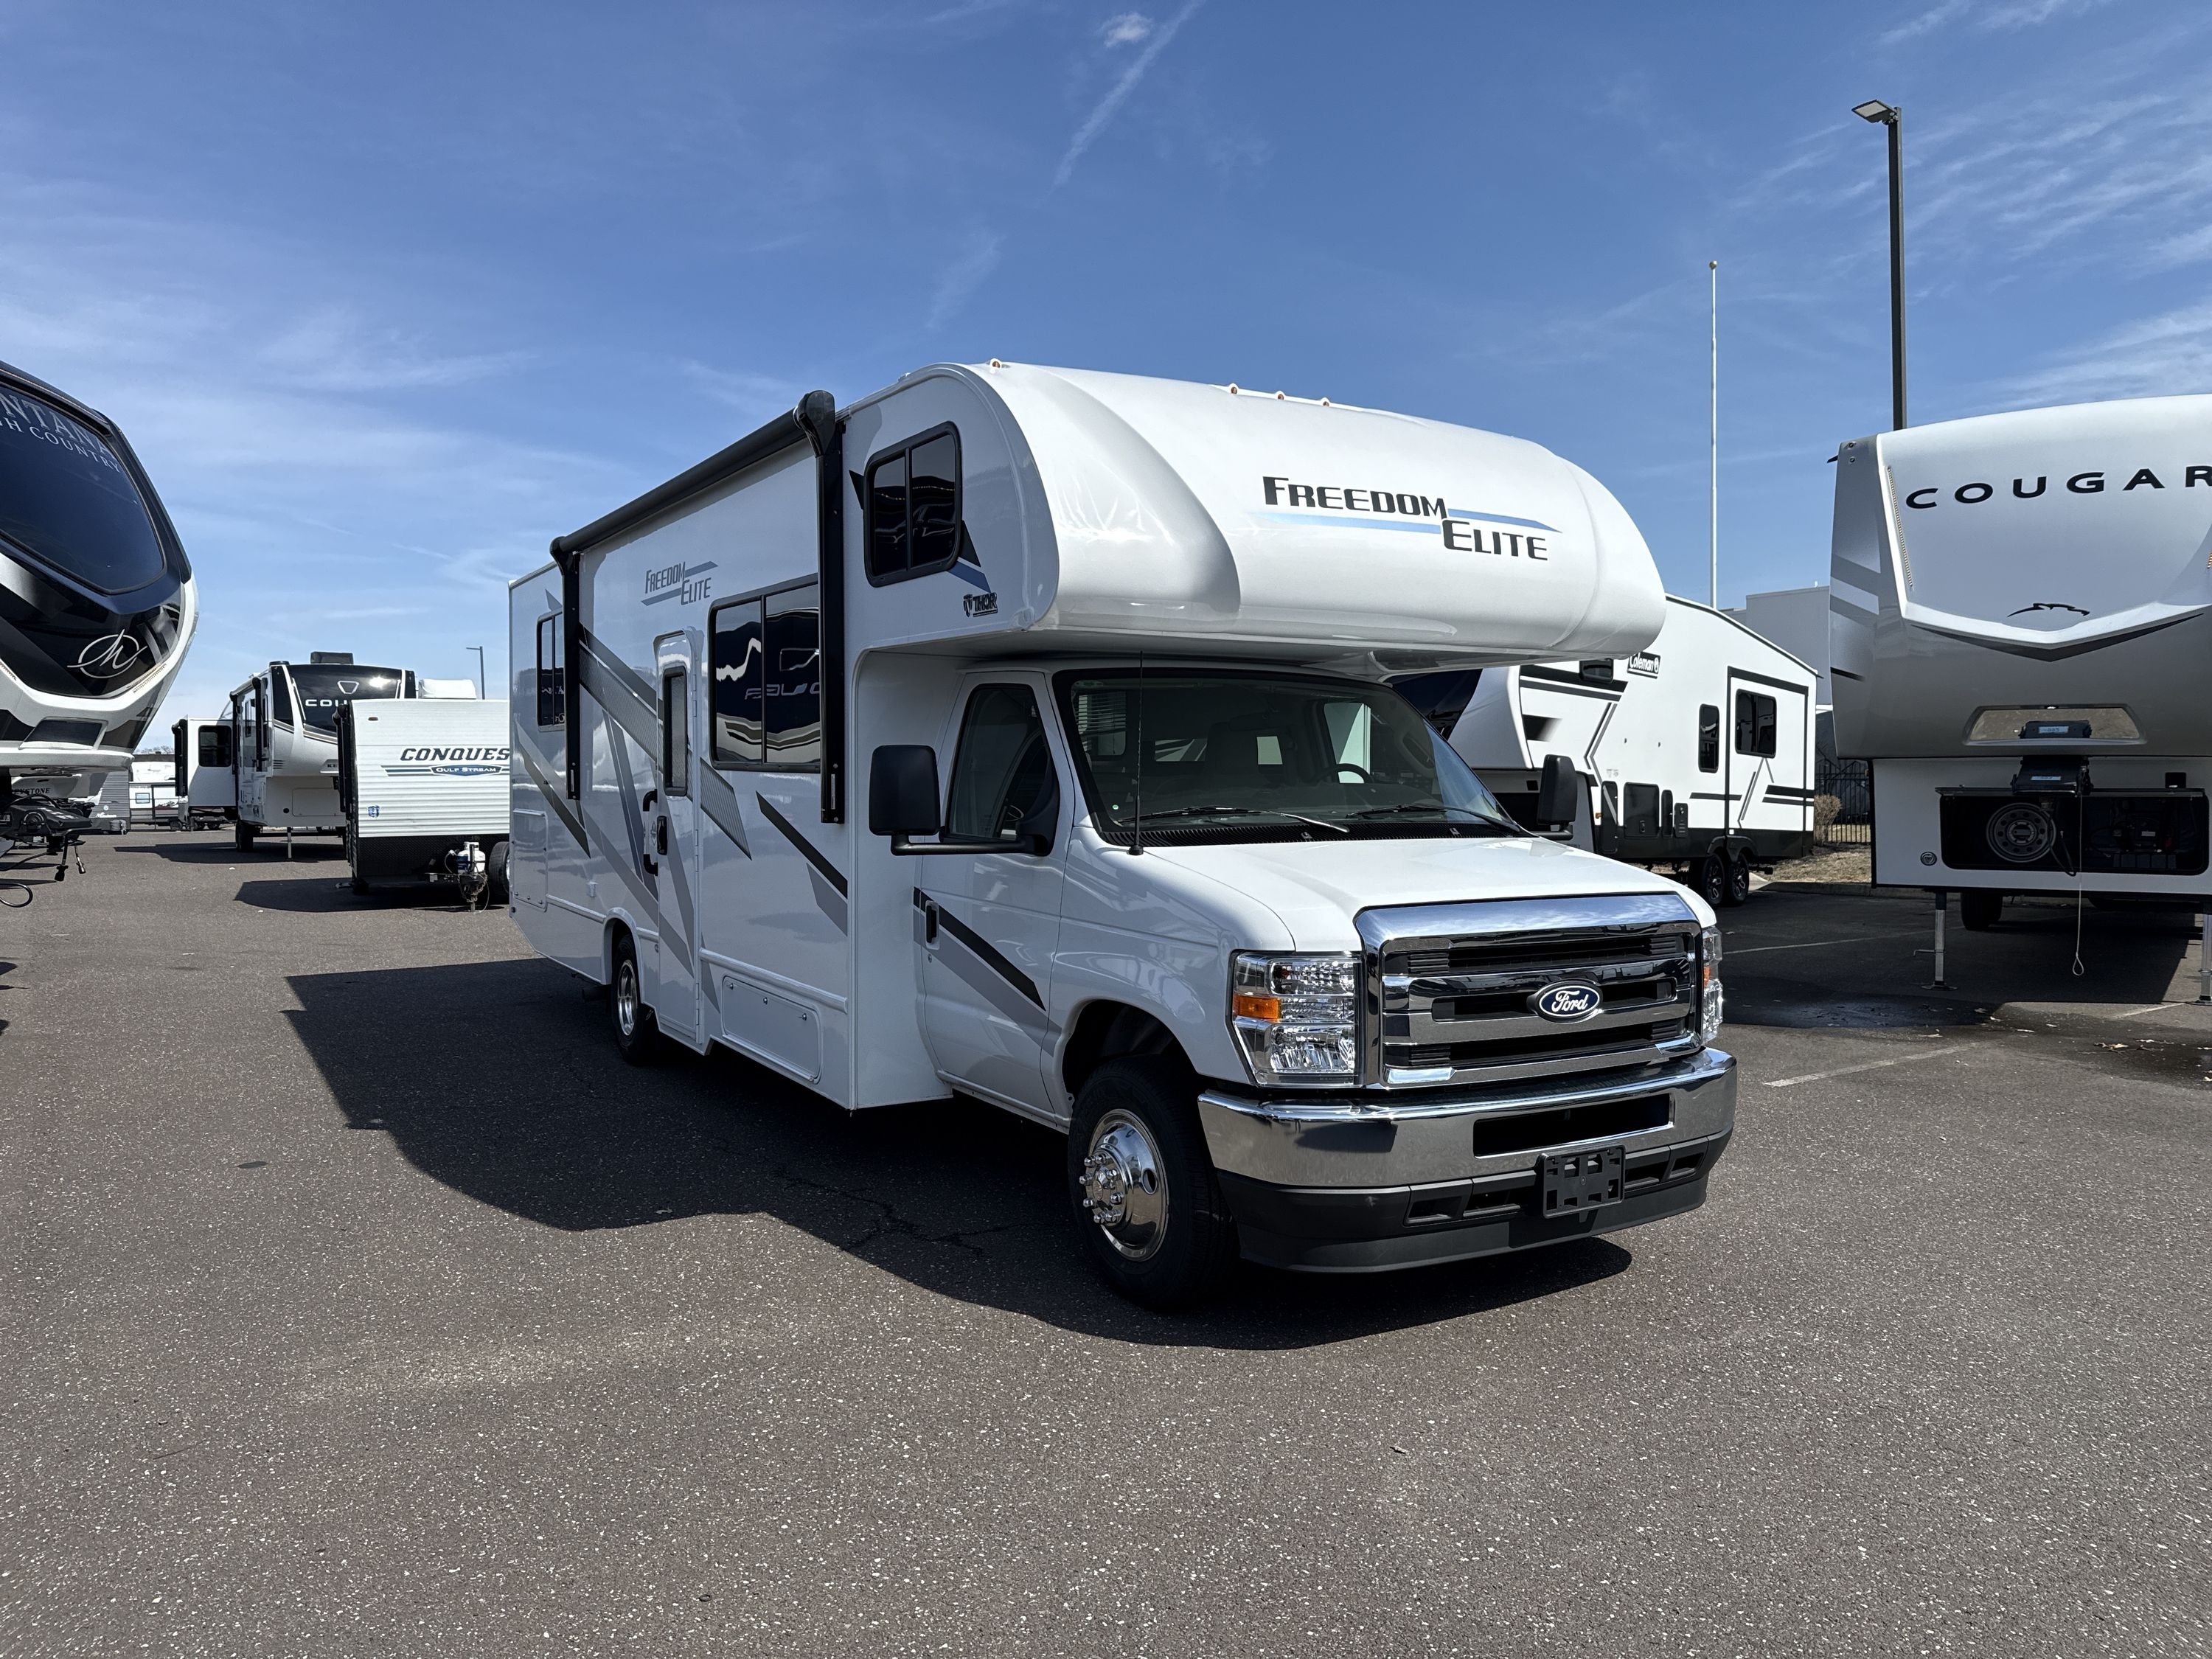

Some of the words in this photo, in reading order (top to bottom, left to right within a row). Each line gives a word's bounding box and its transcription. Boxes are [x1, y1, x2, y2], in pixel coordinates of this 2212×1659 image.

[29, 426, 120, 473] COUNTRY
[1262, 476, 1447, 519] FREEDOM
[1905, 465, 2212, 509] COUGAR
[1441, 519, 1548, 561] ELITE
[645, 561, 686, 594] FREEDOM
[681, 577, 712, 605] ELITE
[973, 592, 998, 612] THOR
[1630, 652, 1654, 672] Coleman
[1551, 990, 1589, 1012] Ford
